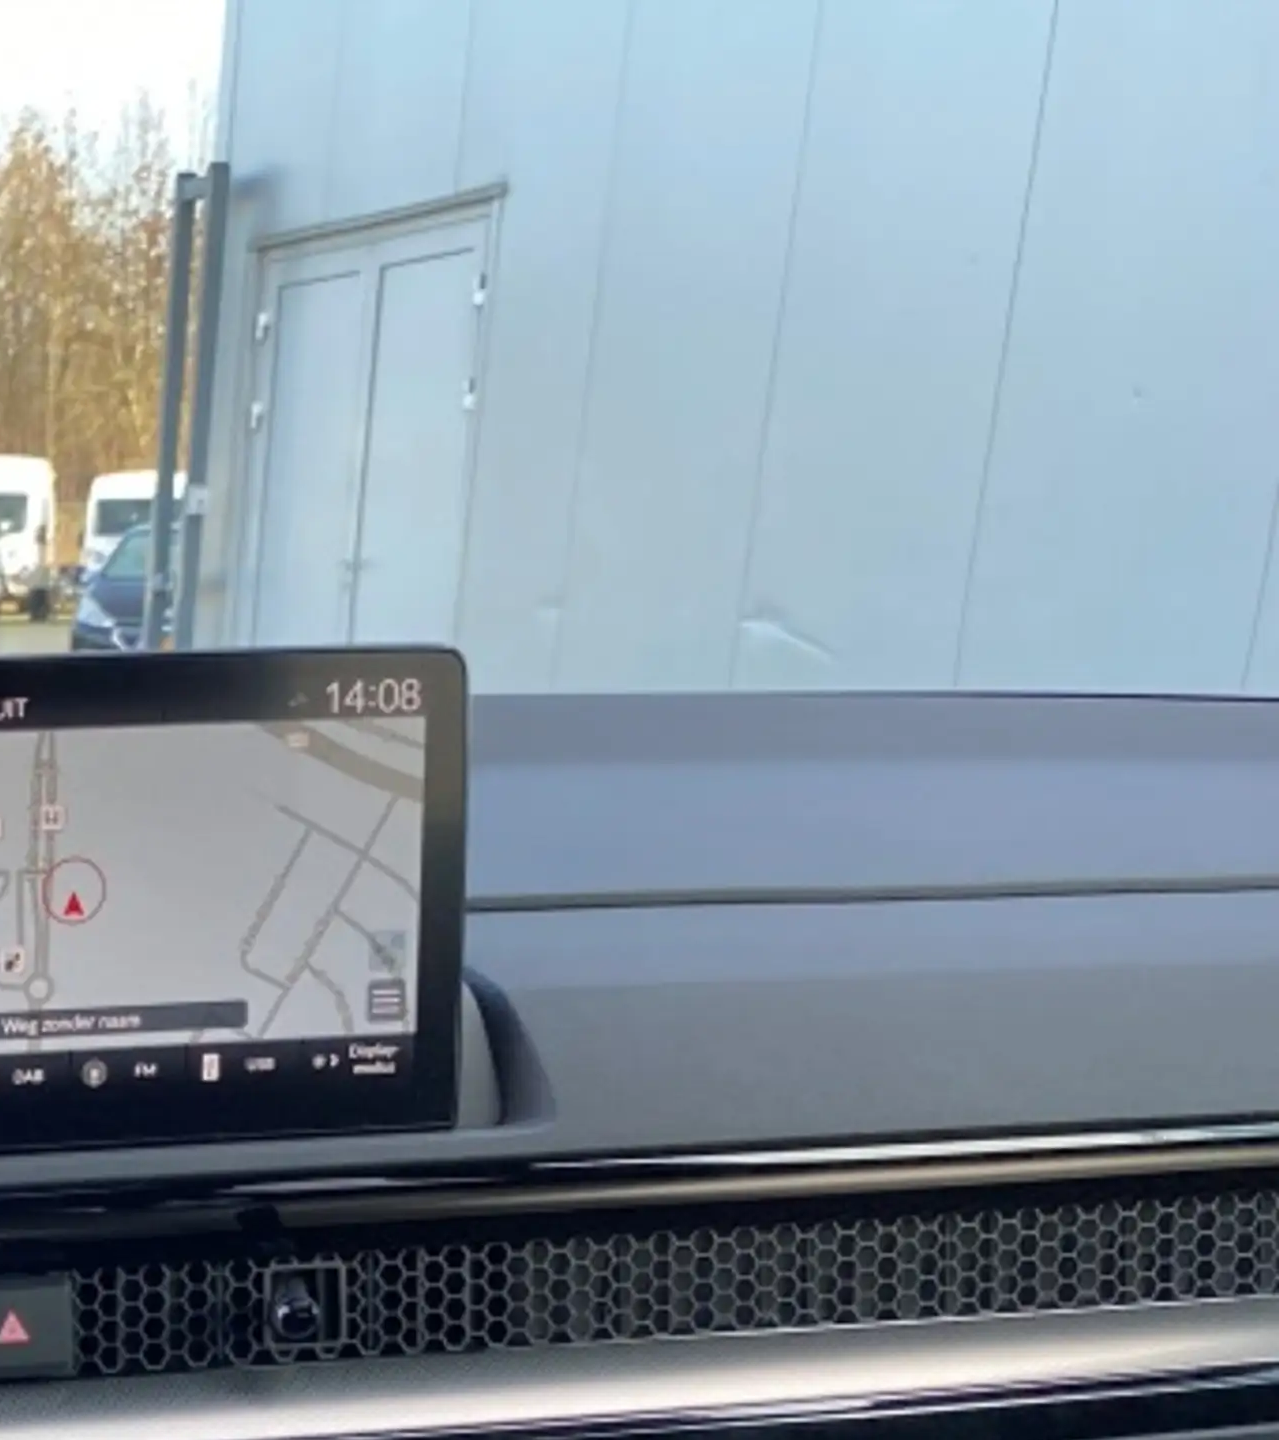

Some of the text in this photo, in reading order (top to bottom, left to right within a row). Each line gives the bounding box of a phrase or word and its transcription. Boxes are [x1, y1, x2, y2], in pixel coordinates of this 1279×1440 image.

[325, 677, 424, 715] 14:08
[0, 1016, 39, 1037] Weg
[41, 1012, 95, 1033] zonder
[11, 1067, 45, 1086] DAB
[133, 1061, 158, 1078] FM
